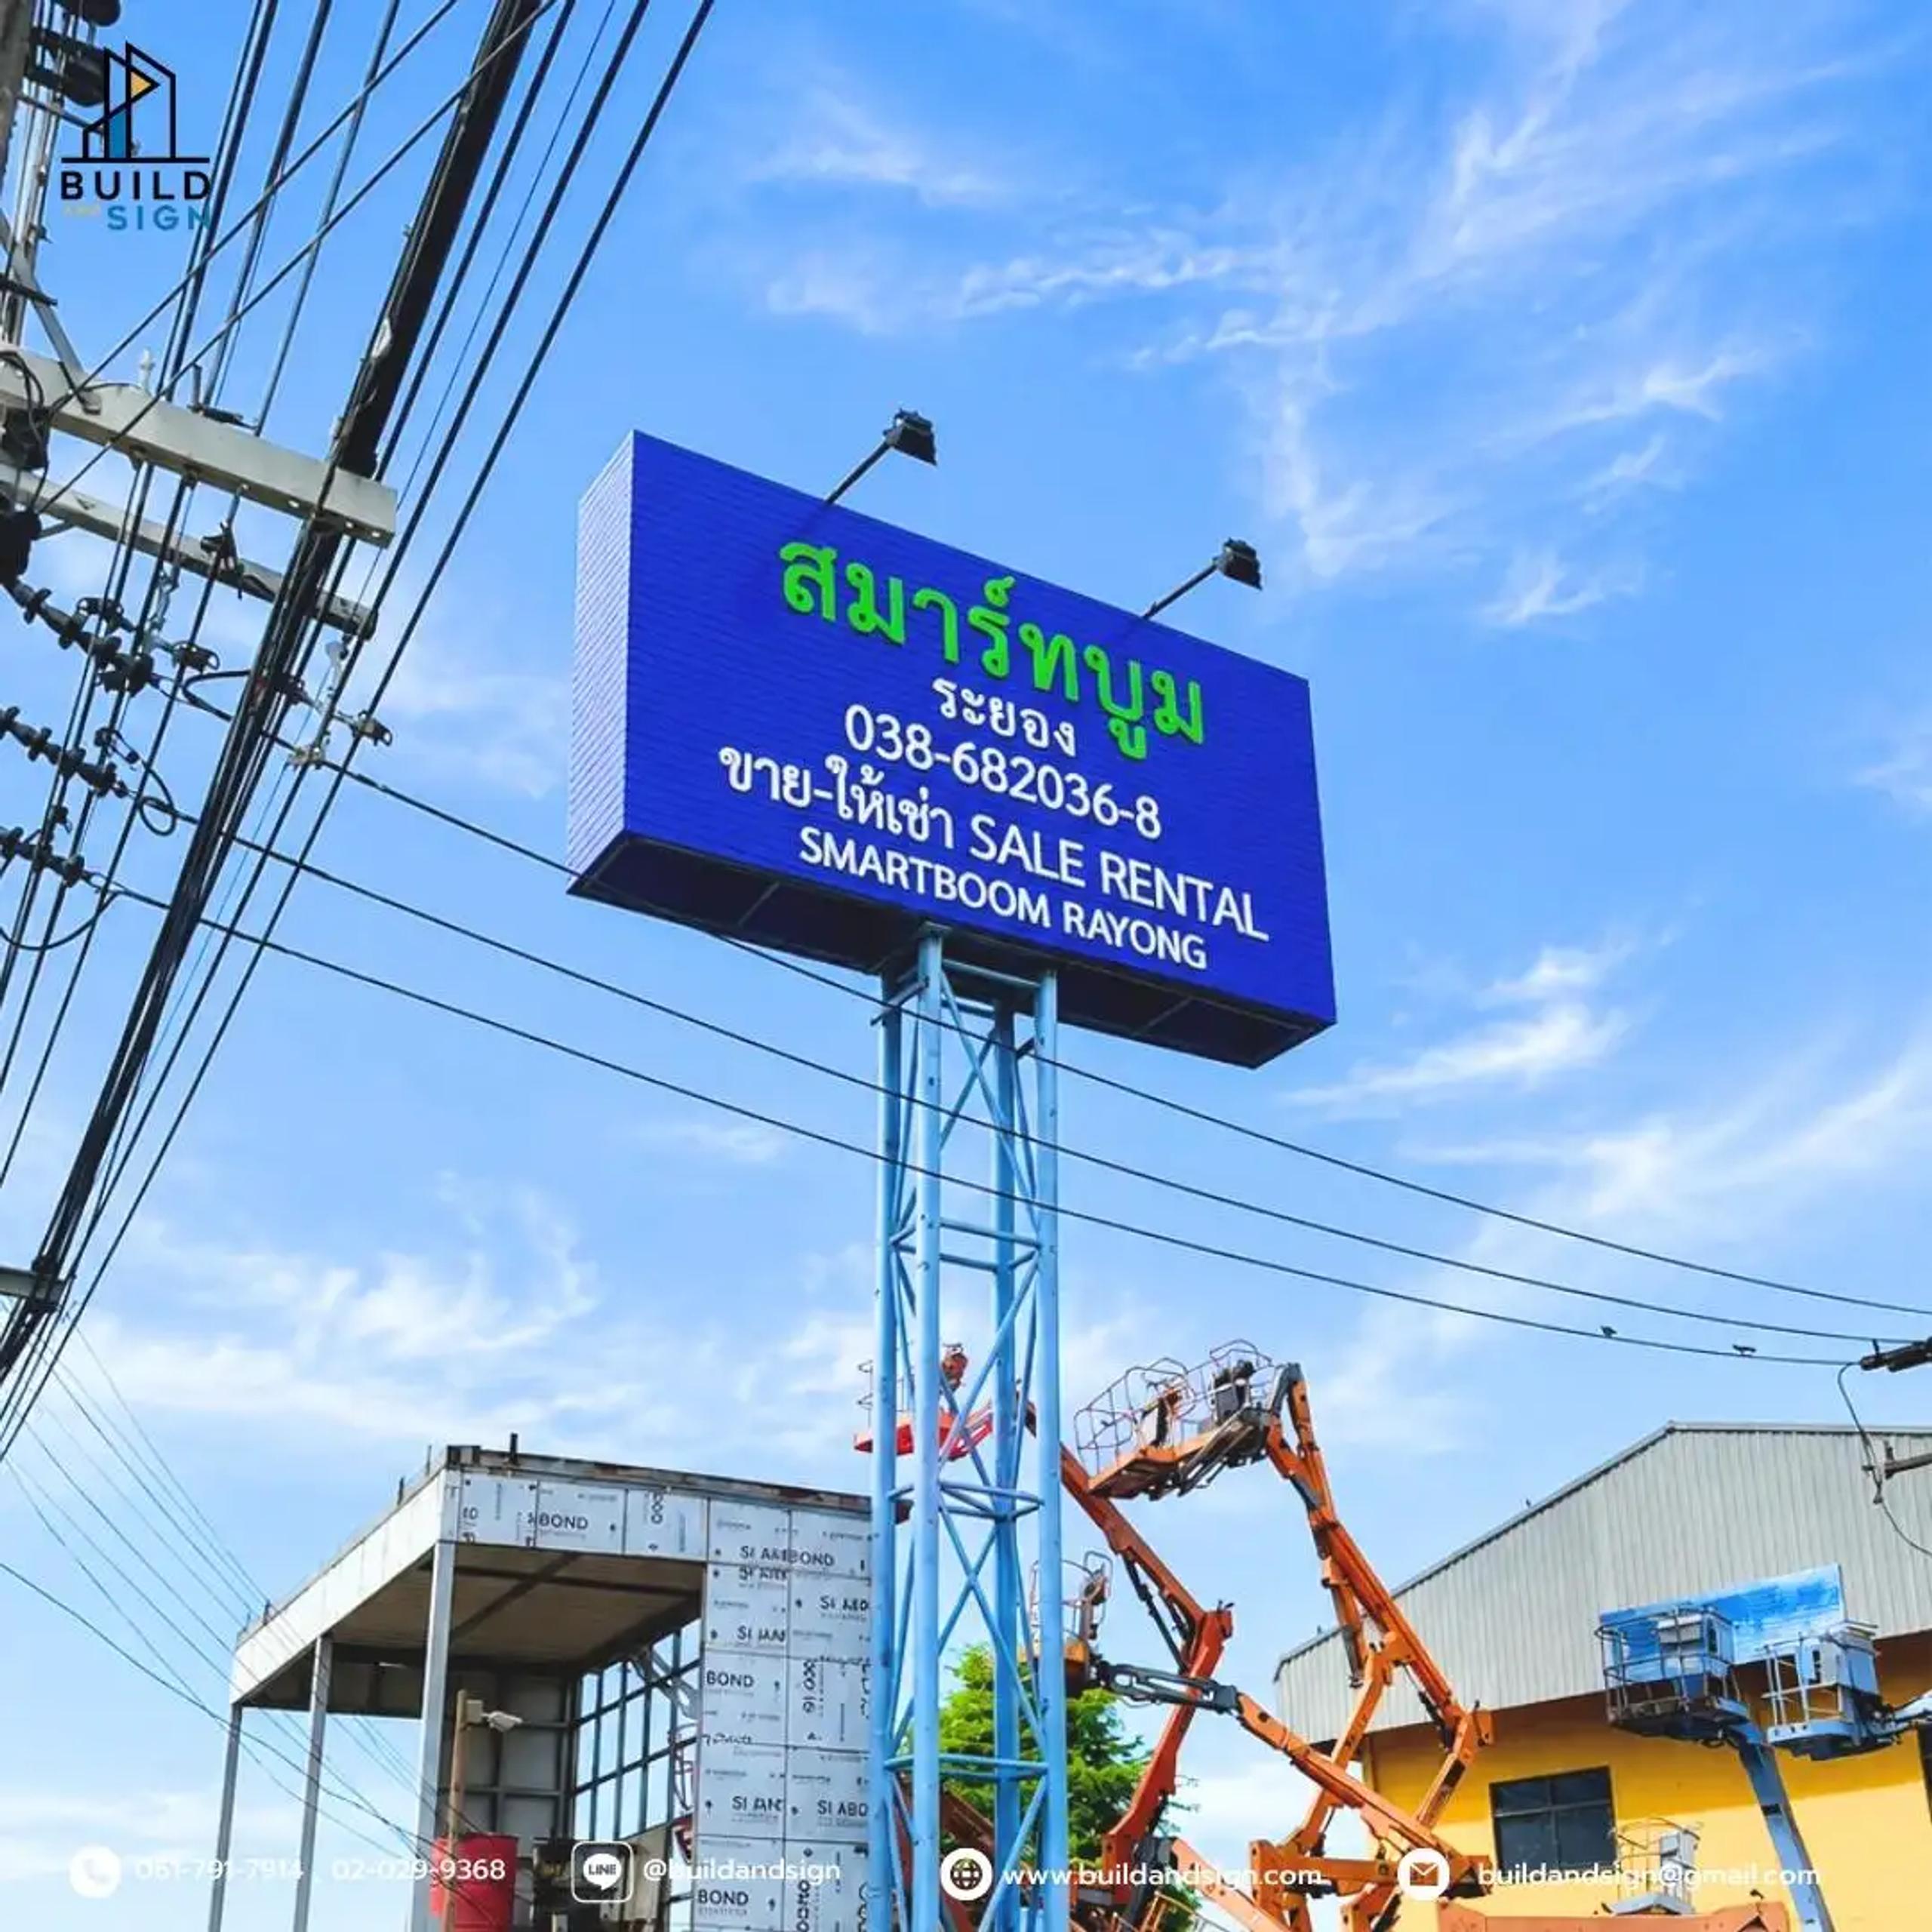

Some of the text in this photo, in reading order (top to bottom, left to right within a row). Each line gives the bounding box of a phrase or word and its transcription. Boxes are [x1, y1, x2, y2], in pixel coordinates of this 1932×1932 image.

[780, 542, 1203, 759] สมาร์ทบูม
[845, 704, 1162, 826] 038-682036-8
[932, 678, 1076, 757] ระยอง
[719, 747, 1269, 942] ขาย-ให้เช่า SALE RENTAL
[799, 826, 1208, 970] SMARTBOOM RAYONG
[538, 1512, 589, 1531] BOND
[706, 1670, 754, 1687] BOND
[697, 1889, 749, 1906] BOND
